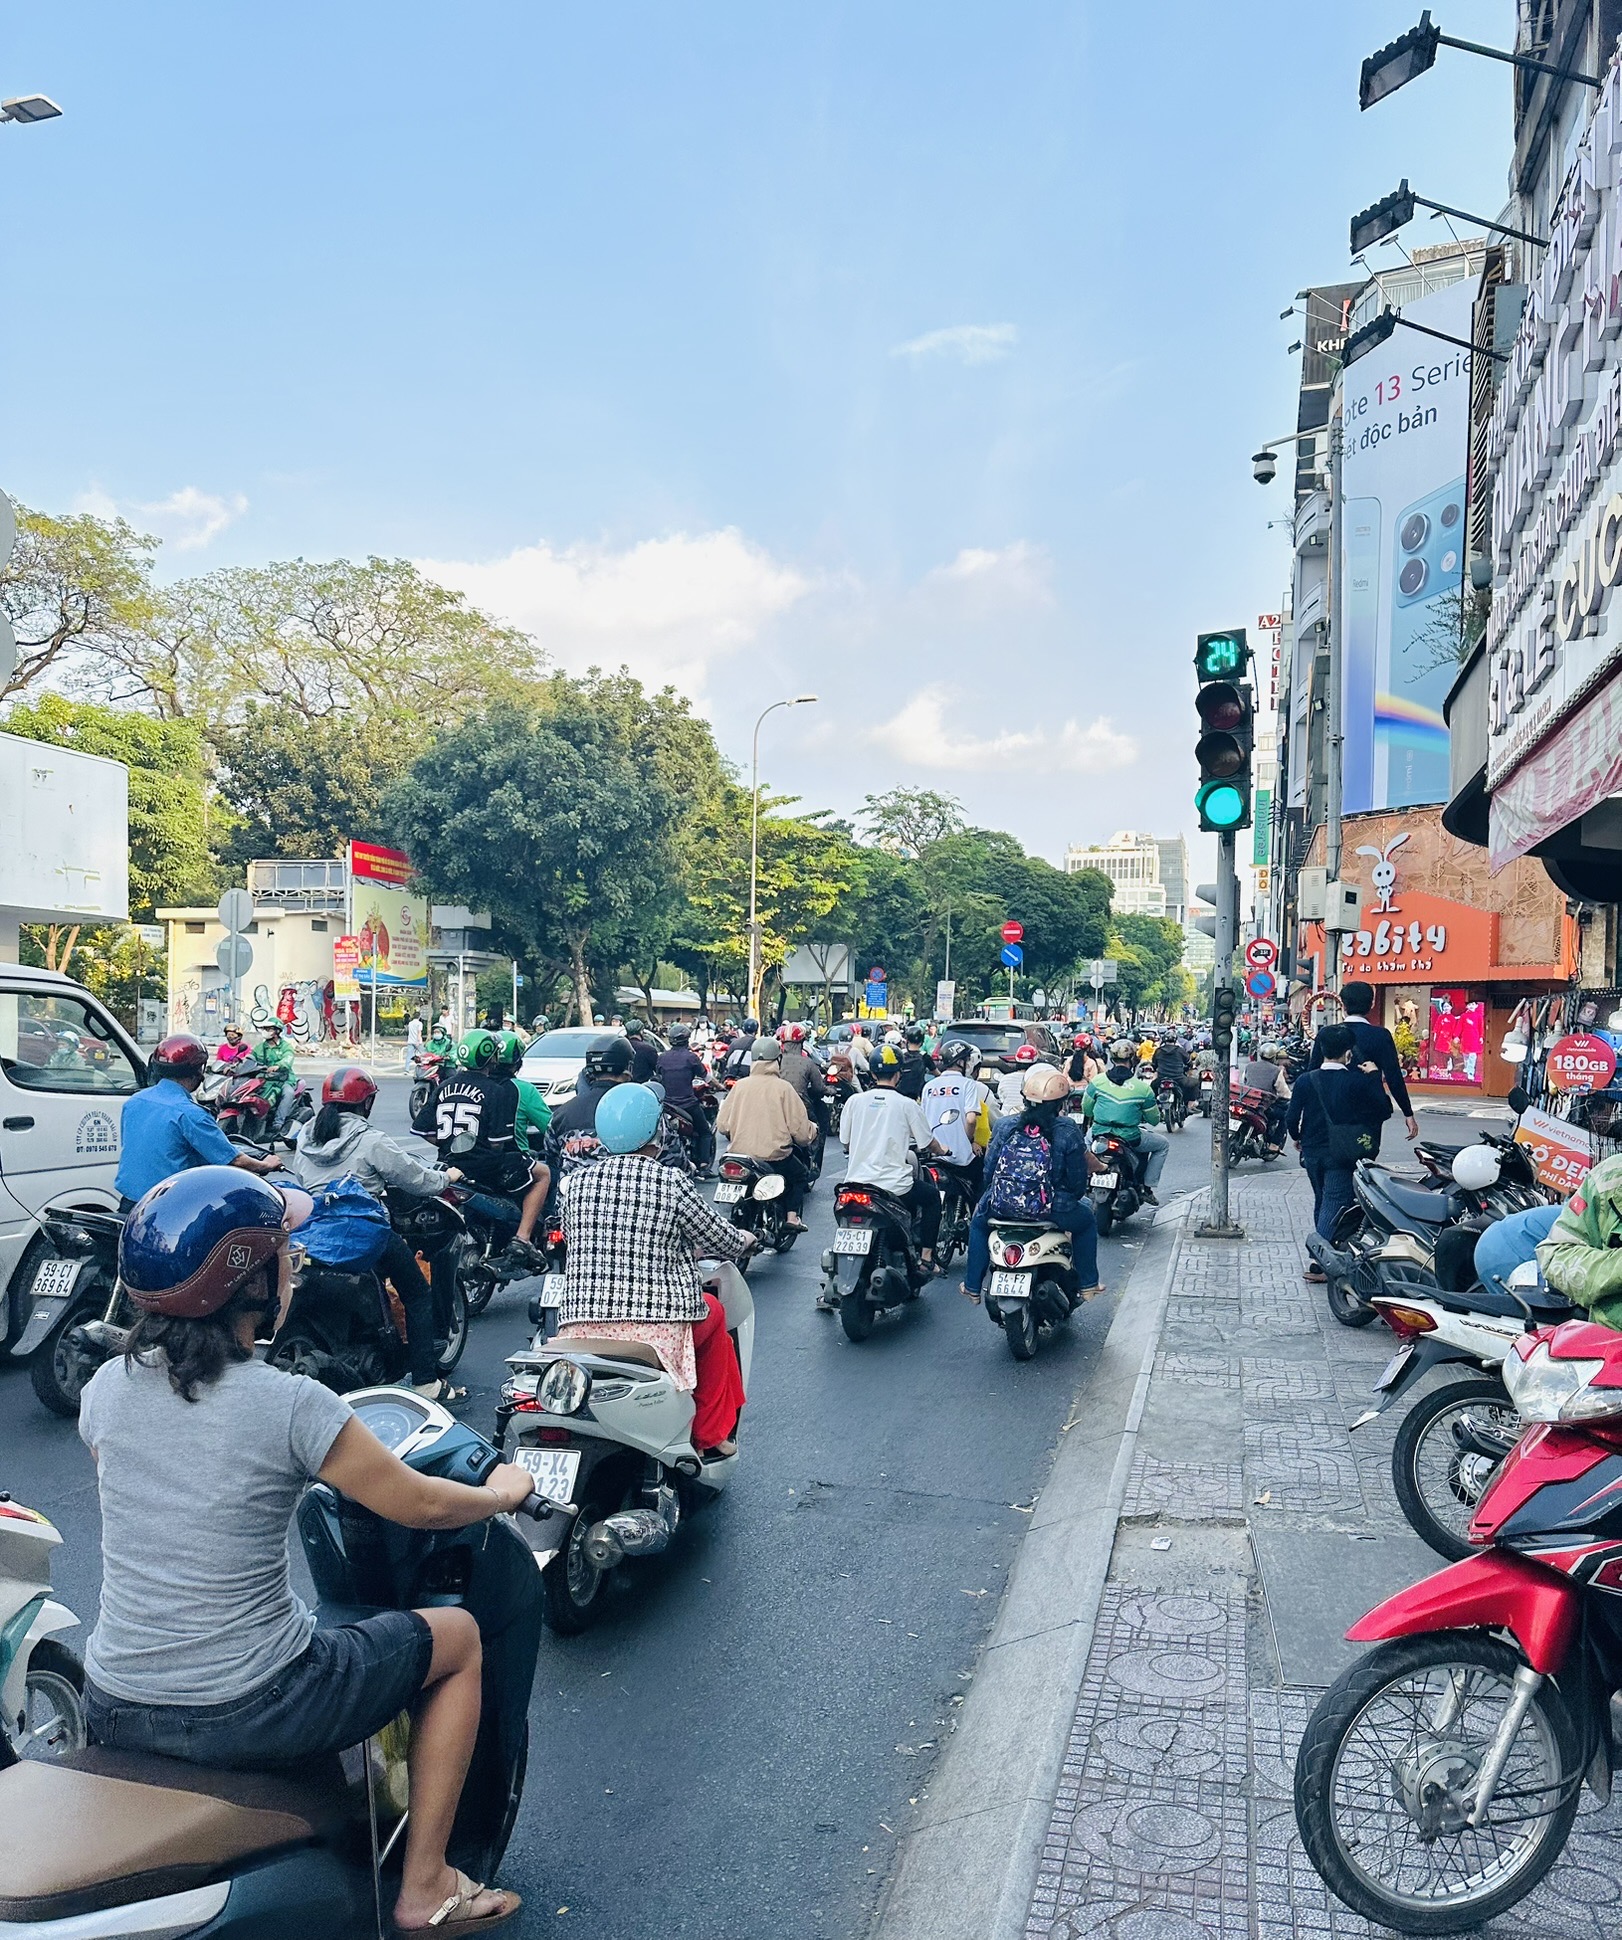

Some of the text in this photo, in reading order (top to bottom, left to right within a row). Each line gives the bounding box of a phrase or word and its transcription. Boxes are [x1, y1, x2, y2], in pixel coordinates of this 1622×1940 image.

[1374, 375, 1401, 406] 13
[1595, 358, 1622, 468] ĐIỆ
[1360, 422, 1391, 449] độc
[1398, 405, 1437, 435] bản
[1491, 304, 1570, 577] QUANG
[1207, 640, 1235, 672] 24
[1360, 963, 1371, 973] do
[1554, 1055, 1608, 1071] 180GB
[1566, 1071, 1594, 1083] tháng
[438, 1083, 485, 1103] WILLIAMS
[927, 1086, 960, 1097] FASEC
[436, 1102, 482, 1140] 55
[1539, 1169, 1559, 1182] PHÍ
[841, 1230, 866, 1241] 75-C1
[44, 1262, 73, 1278] 59-C1
[998, 1273, 1026, 1284] 54-F2
[996, 1284, 1024, 1295] 6644
[523, 1452, 568, 1476] 59-X4
